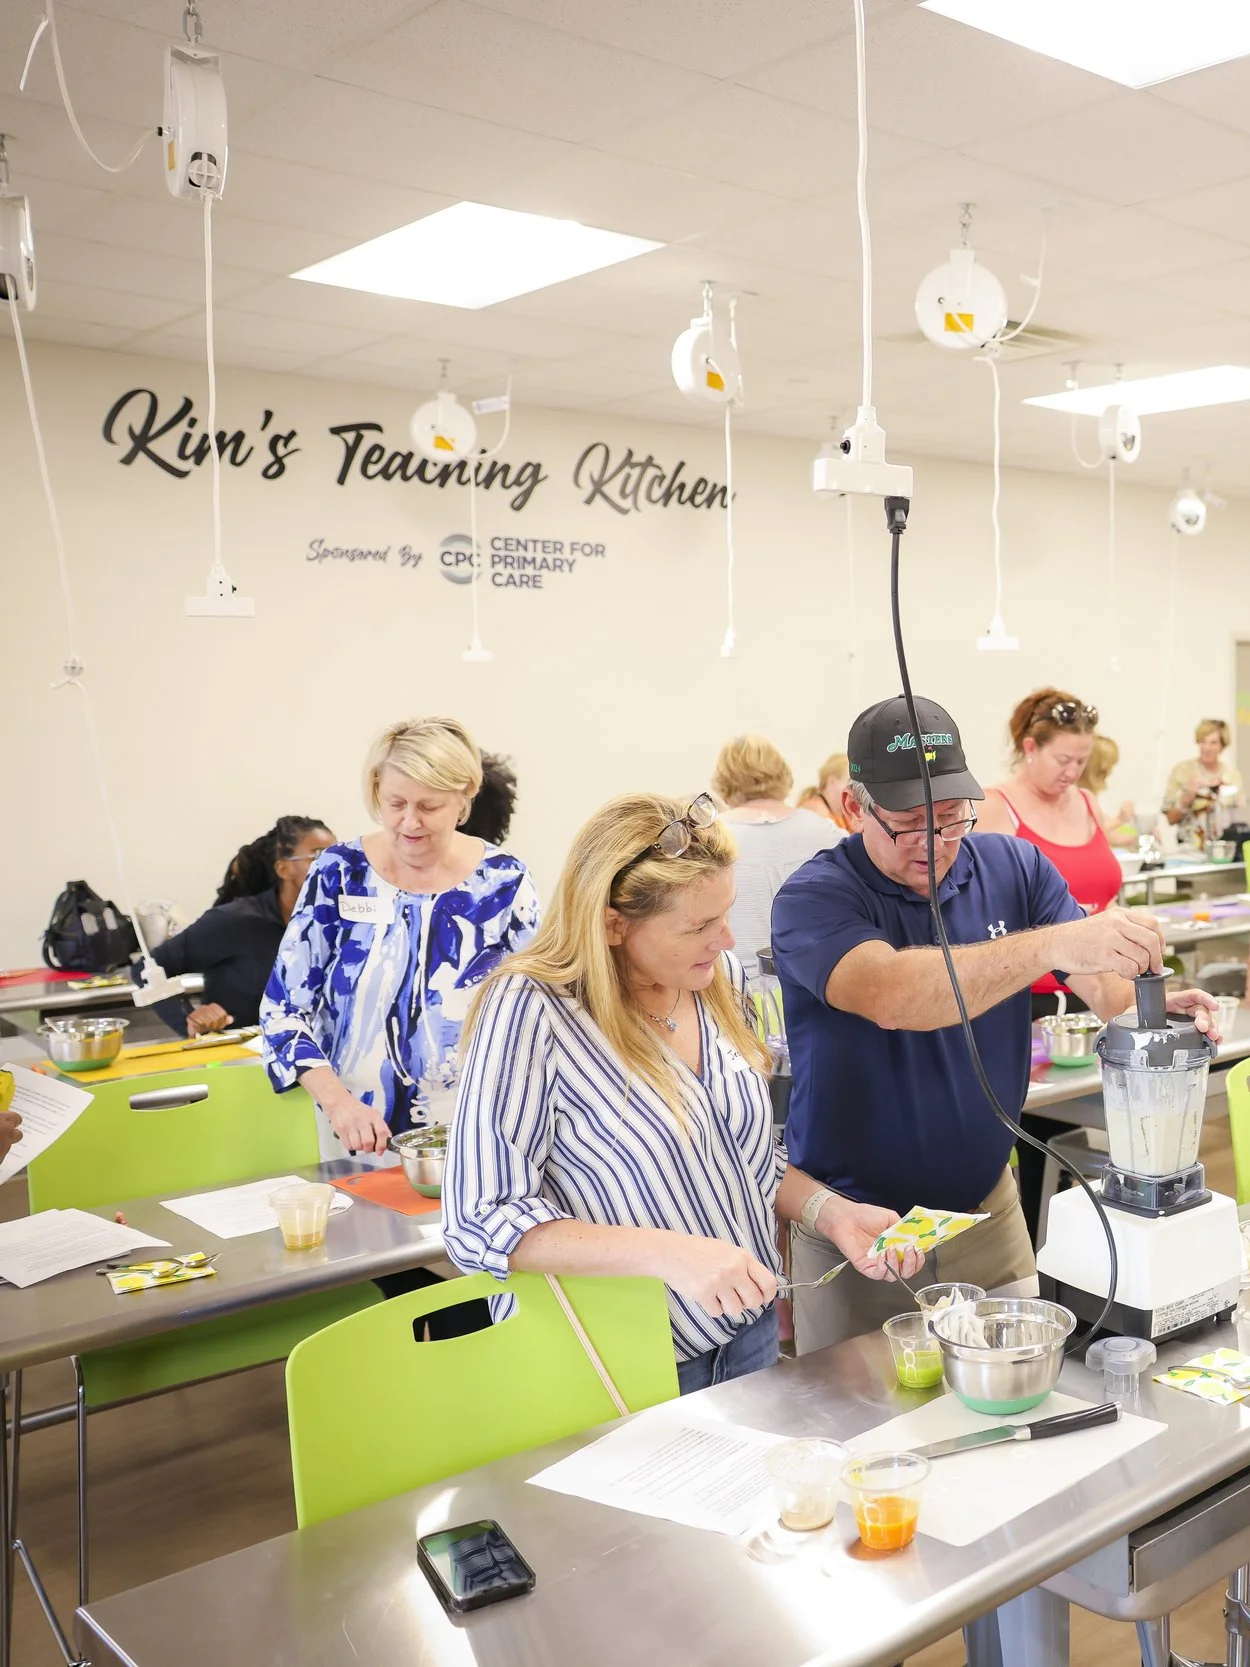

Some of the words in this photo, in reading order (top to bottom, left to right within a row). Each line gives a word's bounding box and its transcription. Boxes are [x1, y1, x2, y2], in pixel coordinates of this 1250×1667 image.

[103, 388, 301, 479] Kim's
[572, 442, 737, 516] Kitchen
[305, 538, 391, 565] Sponsored
[398, 544, 423, 569] By
[490, 536, 564, 555] CENTER
[569, 541, 607, 558] FOR
[440, 550, 482, 568] CPC
[491, 554, 577, 573] PRIMARY
[491, 572, 544, 589] CARE
